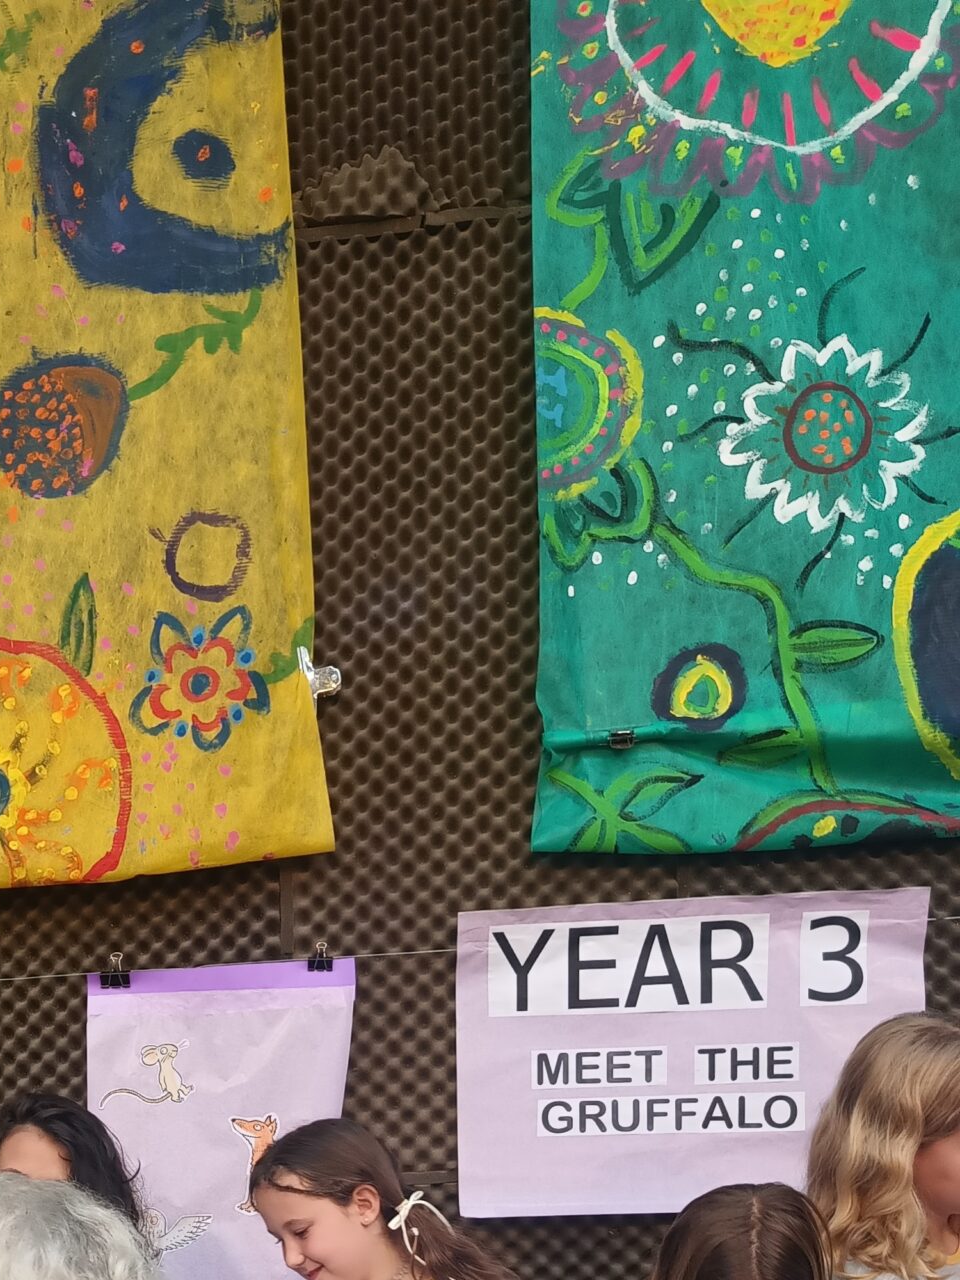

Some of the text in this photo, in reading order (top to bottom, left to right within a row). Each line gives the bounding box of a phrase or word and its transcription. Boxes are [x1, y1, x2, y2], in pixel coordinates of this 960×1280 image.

[492, 915, 865, 1012] YEAR 3
[536, 1045, 794, 1085] MEET THE
[541, 1095, 798, 1134] GRUFFALO
